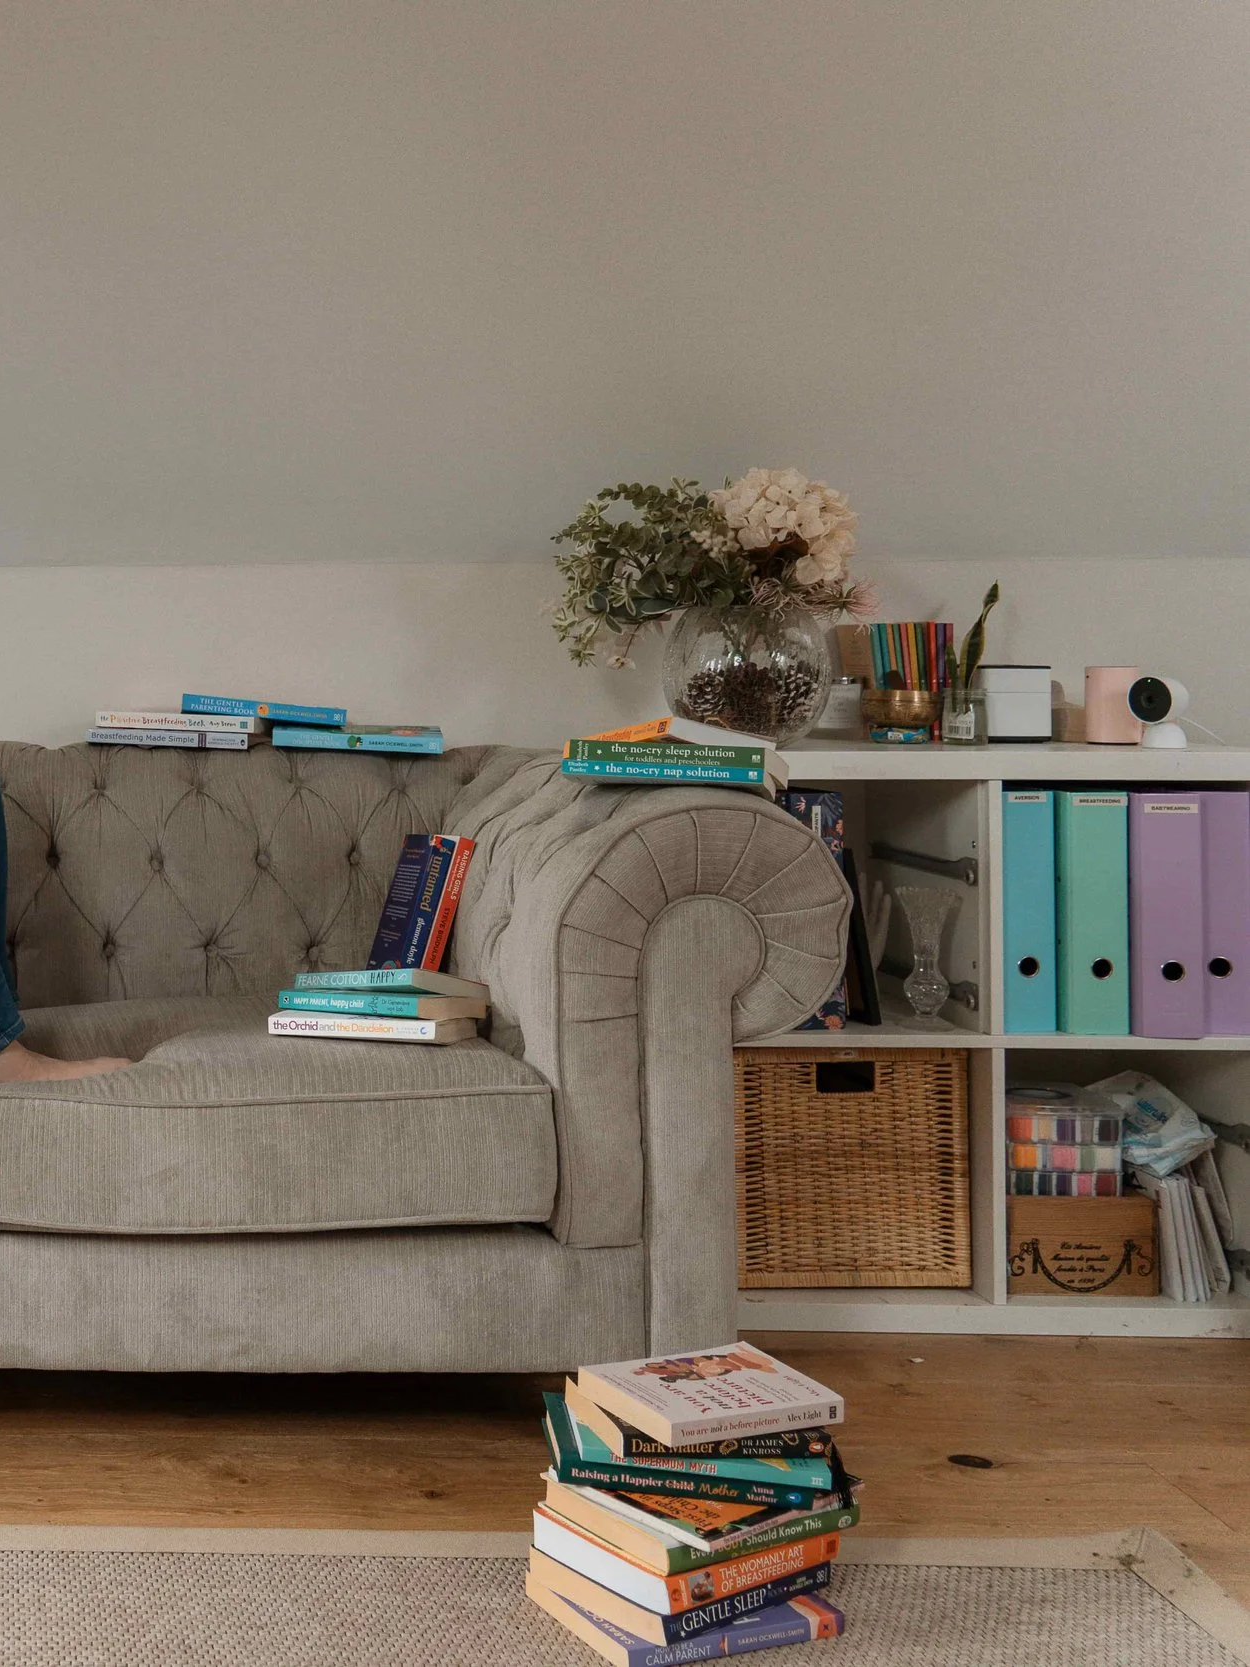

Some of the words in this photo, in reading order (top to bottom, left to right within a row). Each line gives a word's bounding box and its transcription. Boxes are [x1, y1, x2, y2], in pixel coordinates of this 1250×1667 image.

[190, 704, 232, 713] PARENTING
[216, 700, 244, 708] GENTLE
[142, 716, 188, 728] Breastfeeding
[92, 732, 144, 742] Breastfeeding
[146, 734, 166, 742] Made
[168, 735, 194, 744] Simple
[612, 744, 628, 753] the
[630, 746, 662, 757] no-cry
[666, 746, 690, 758] sleep
[694, 748, 736, 758] solution
[624, 754, 634, 762] for
[636, 755, 662, 764] toddlers
[664, 756, 676, 764] and
[678, 757, 720, 766] preschoolers
[606, 764, 622, 773] the
[626, 766, 660, 777] no-cry
[664, 767, 683, 778] nap
[686, 768, 730, 778] solution
[456, 850, 470, 879] RAISING
[450, 880, 460, 900] GIRLS
[406, 944, 418, 964] doyle
[298, 974, 328, 986] FEARNE
[330, 974, 366, 986] COTTON
[370, 971, 396, 984] HAPPY
[330, 998, 350, 1009] happy
[350, 999, 364, 1008] child
[274, 1020, 288, 1030] the
[288, 1020, 318, 1031] Orchid
[320, 1021, 336, 1032] and
[336, 1022, 350, 1032] the
[352, 1023, 394, 1033] Dandelion
[658, 1383, 687, 1396] are
[703, 1382, 751, 1409] before
[715, 1377, 774, 1406] picture
[688, 1395, 713, 1414] You
[710, 1395, 733, 1410] not
[680, 1427, 696, 1437] You
[710, 1424, 722, 1433] not
[728, 1420, 752, 1431] before
[752, 1416, 780, 1430] picture
[787, 1413, 802, 1423] Alex
[803, 1410, 822, 1422] Light
[632, 1438, 666, 1454] Dark
[755, 1439, 784, 1447] JAMES
[610, 1452, 627, 1464] THE
[632, 1456, 685, 1471] SUPERMUM
[688, 1462, 718, 1476] MYTH
[572, 1468, 610, 1483] Raising
[620, 1473, 663, 1490] Happier
[664, 1478, 694, 1492] Child
[698, 1482, 739, 1498] Mother
[751, 1486, 774, 1495] Anna
[746, 1493, 779, 1504] Mathur
[654, 1500, 682, 1516] Steps
[685, 1512, 712, 1528] First
[746, 1529, 777, 1546] Should
[778, 1524, 802, 1538] Know
[804, 1518, 822, 1530] This
[718, 1565, 738, 1580] THE
[738, 1550, 786, 1573] WOMANLY
[787, 1544, 804, 1558] ART
[721, 1580, 734, 1593] OF
[736, 1558, 804, 1589] BREASTFEEDING
[681, 1600, 732, 1632] GENTLE
[734, 1588, 767, 1614] SLEEP
[738, 1636, 758, 1646] SARAH
[759, 1628, 805, 1644] OCKWELL-SMITH
[646, 1654, 674, 1666] CALM
[675, 1646, 712, 1664] PARENT
[672, 1644, 680, 1652] TO
